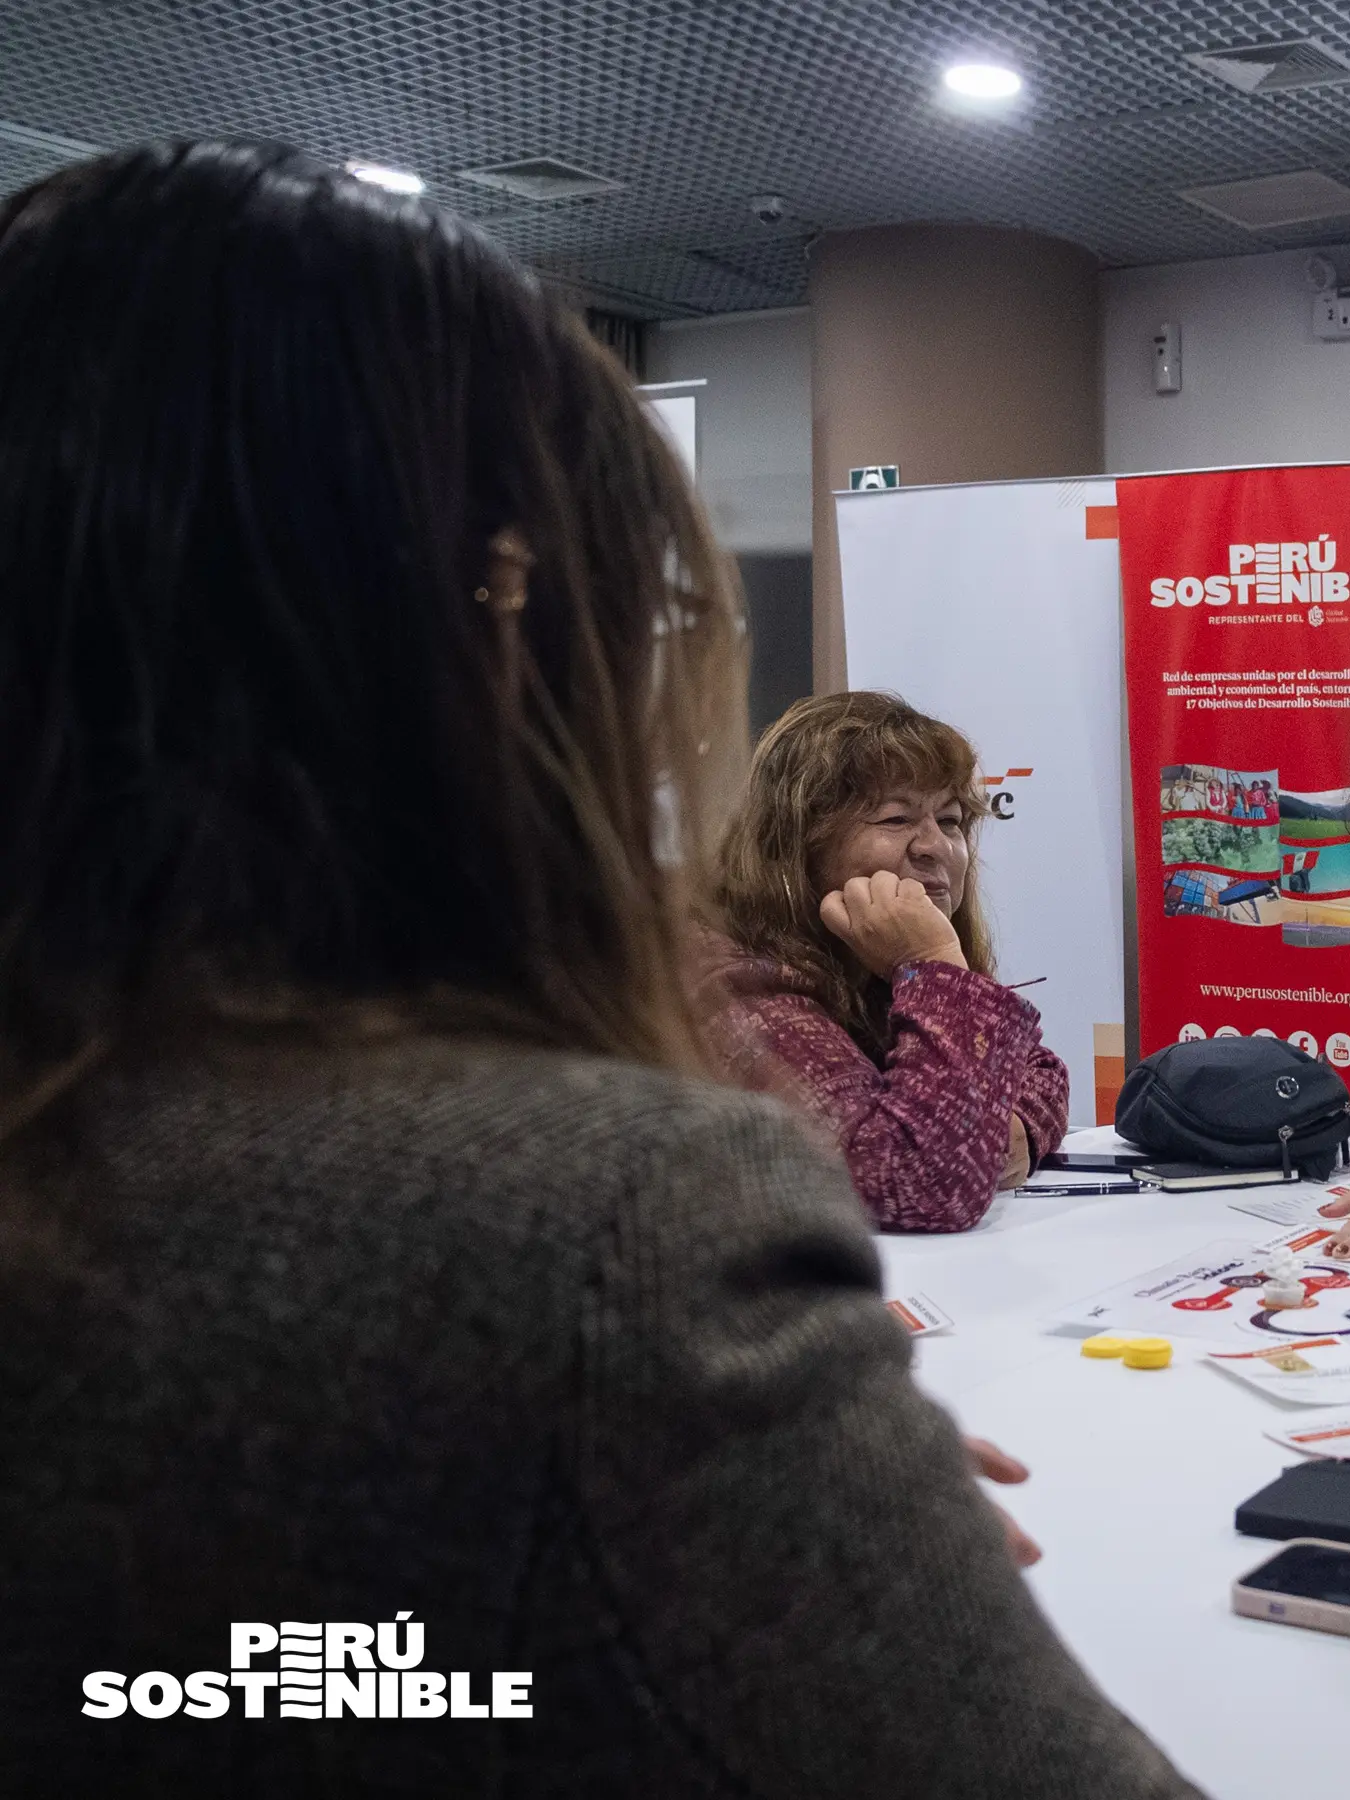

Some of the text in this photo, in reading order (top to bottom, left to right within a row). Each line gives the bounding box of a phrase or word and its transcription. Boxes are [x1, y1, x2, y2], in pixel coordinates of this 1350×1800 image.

[1229, 534, 1336, 575] PERÚ
[1208, 613, 1304, 625] REPRESENTANTE DEL
[1162, 672, 1180, 682] Red
[1181, 671, 1194, 681] de
[1195, 673, 1242, 684] empresas
[1242, 670, 1276, 681] unidas
[1277, 671, 1295, 683] por
[1297, 669, 1308, 680] el
[1167, 684, 1217, 696] ambiental
[1218, 687, 1226, 697] y
[1225, 683, 1278, 696] económico
[1279, 684, 1296, 694] del
[1296, 683, 1321, 696] país,
[1186, 699, 1196, 709] 17
[1198, 698, 1244, 710] Objetivos
[1245, 698, 1257, 709] de
[1258, 698, 1311, 709] Desarrollo
